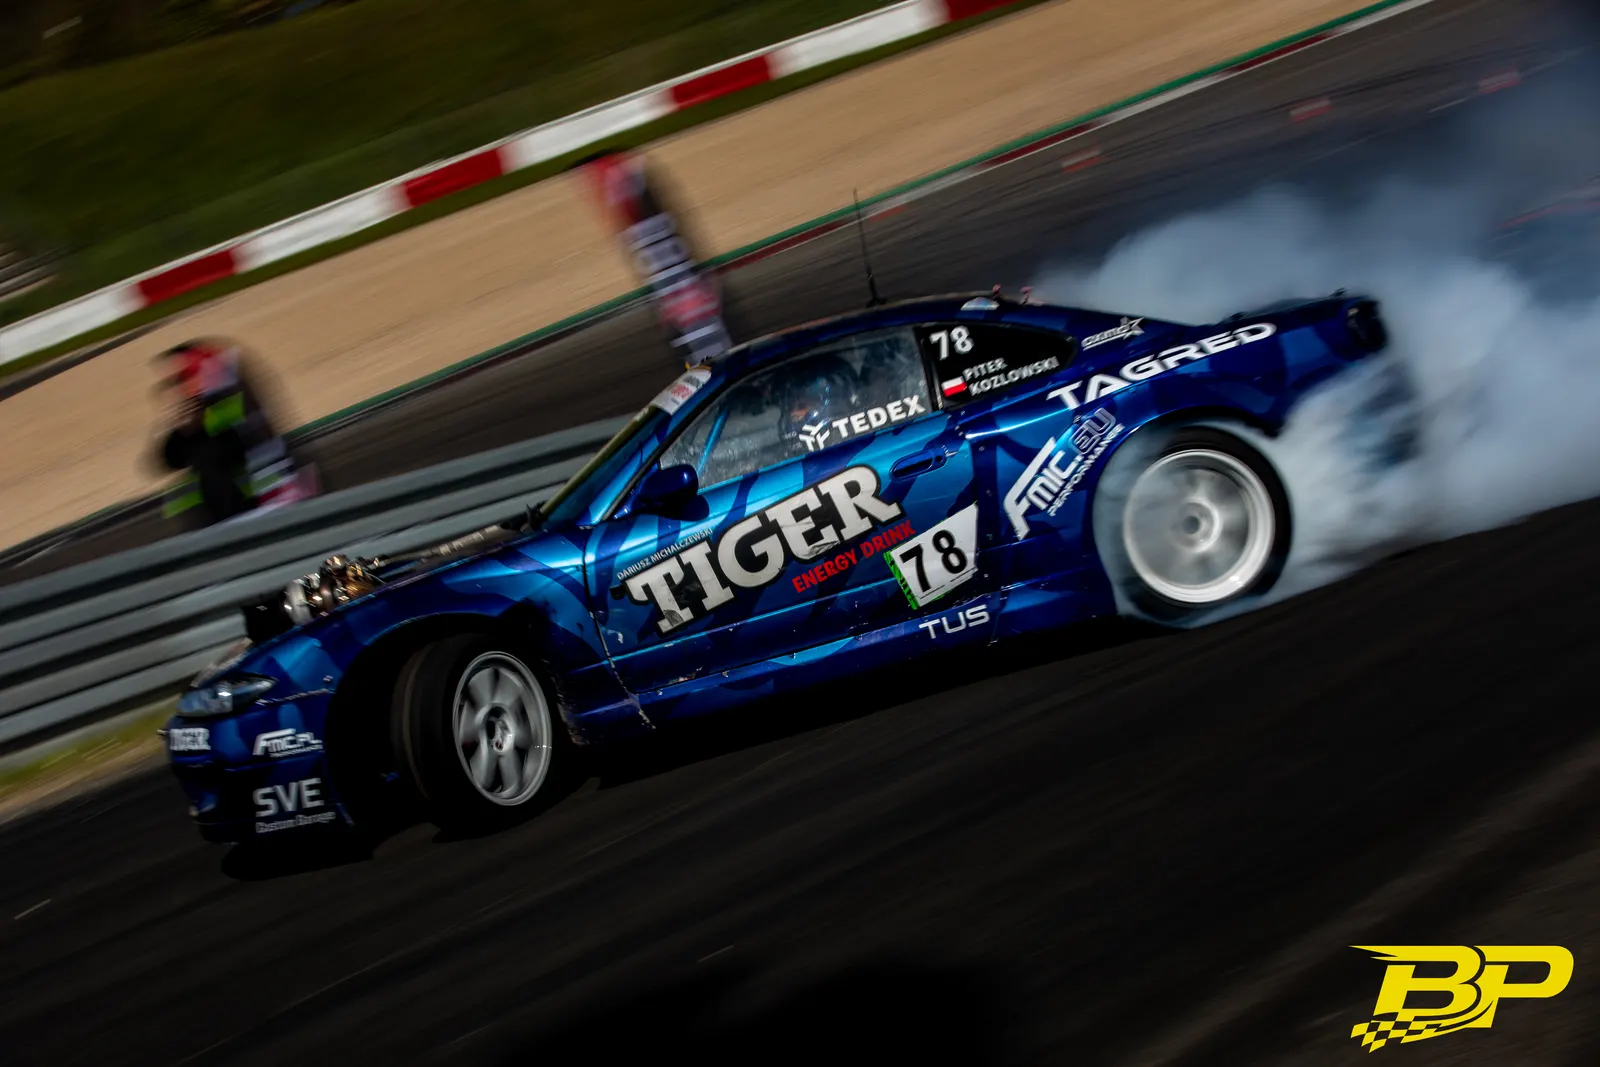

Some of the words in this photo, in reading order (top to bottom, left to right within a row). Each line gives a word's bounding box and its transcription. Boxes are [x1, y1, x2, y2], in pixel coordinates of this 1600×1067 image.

[929, 325, 975, 361] 78
[1046, 322, 1278, 411] TAGRED
[962, 357, 1008, 382] PITER
[968, 355, 1060, 397] KOZLOWSKI
[831, 394, 926, 440] TEDEX
[1047, 422, 1126, 517] PERFORMANCE
[616, 555, 652, 581] DARIUSZ
[650, 527, 714, 564] MICHALCZEWSKI
[625, 465, 902, 634] TIGER
[792, 547, 858, 593] ENERGY
[859, 519, 917, 559] DRINK
[899, 529, 968, 593] 78
[918, 604, 990, 639] TUS
[253, 777, 325, 818] SVE
